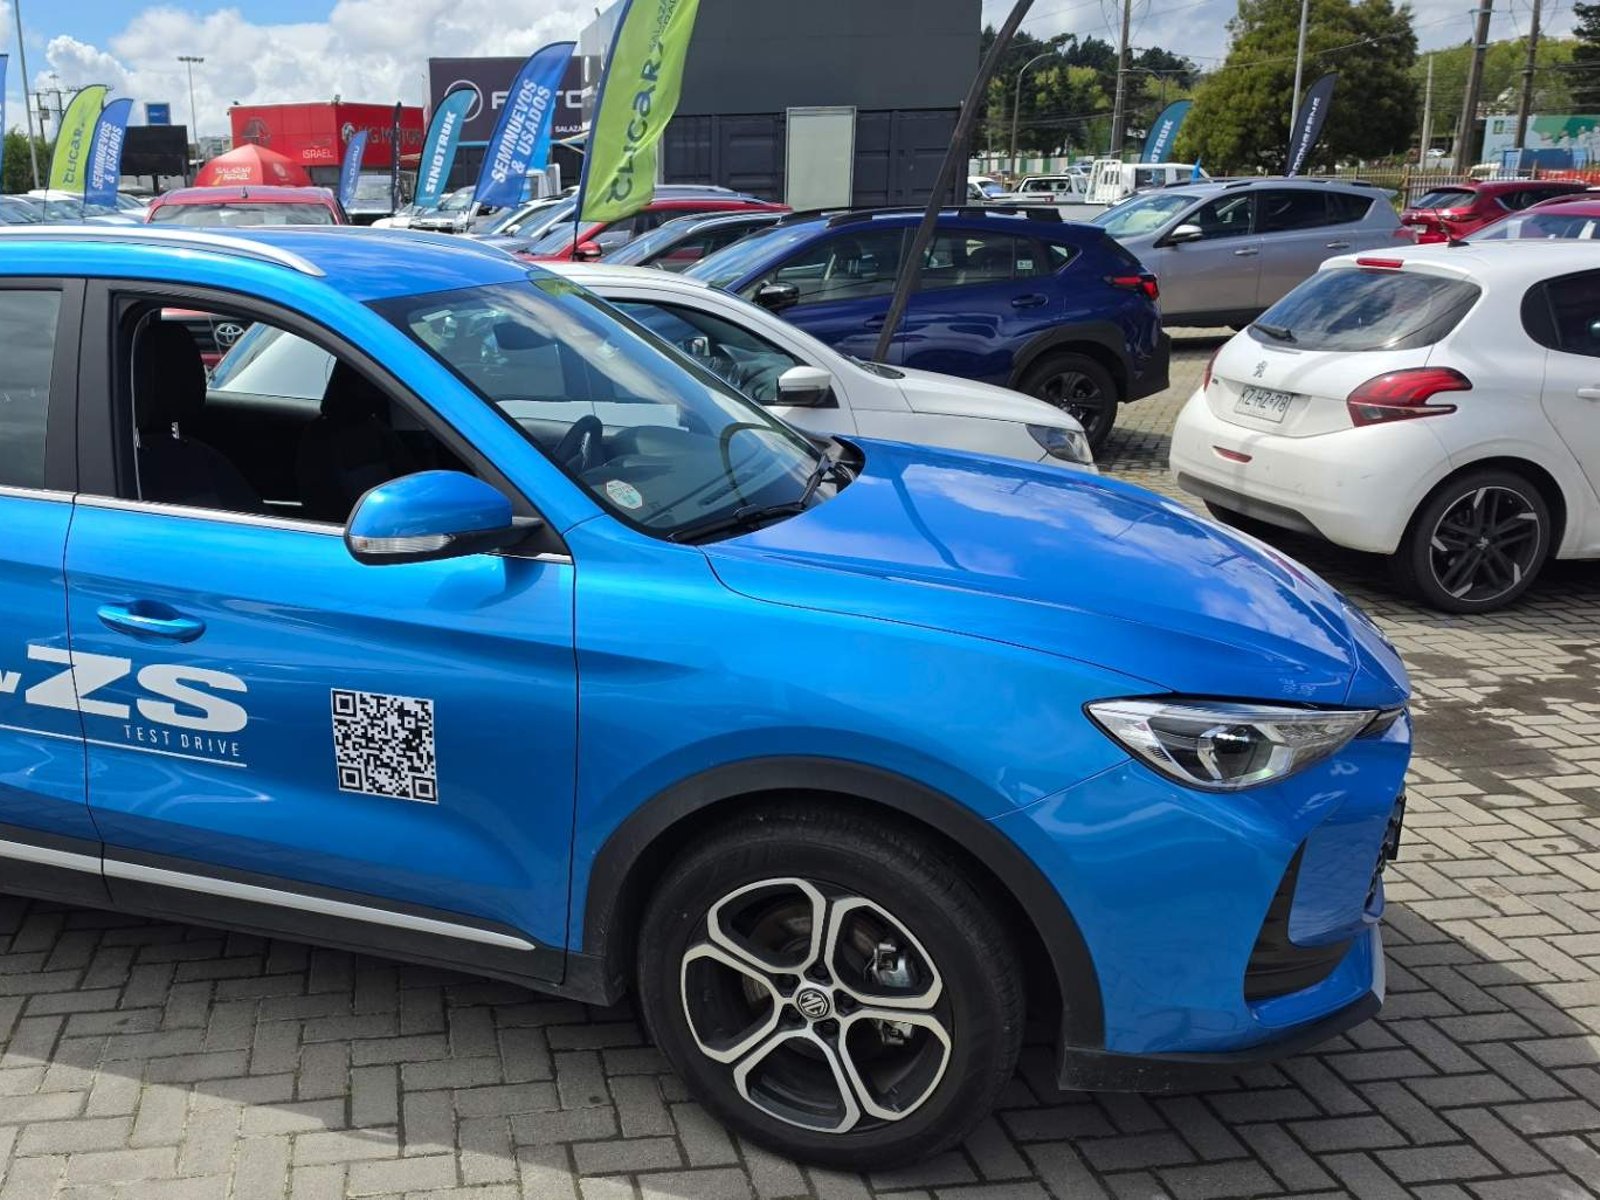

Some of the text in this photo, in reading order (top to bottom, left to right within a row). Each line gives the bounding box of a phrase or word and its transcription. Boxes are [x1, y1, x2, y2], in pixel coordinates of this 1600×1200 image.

[92, 121, 112, 190] SEMINUEVOS
[106, 125, 123, 172] USADOS
[302, 148, 334, 159] ISRAEL
[425, 110, 457, 193] SINOTRUK
[491, 79, 538, 183] SEMINUEVOS
[511, 85, 551, 174] & USADOS
[25, 644, 248, 733] ZS
[123, 725, 241, 757] TEST DRIVE
